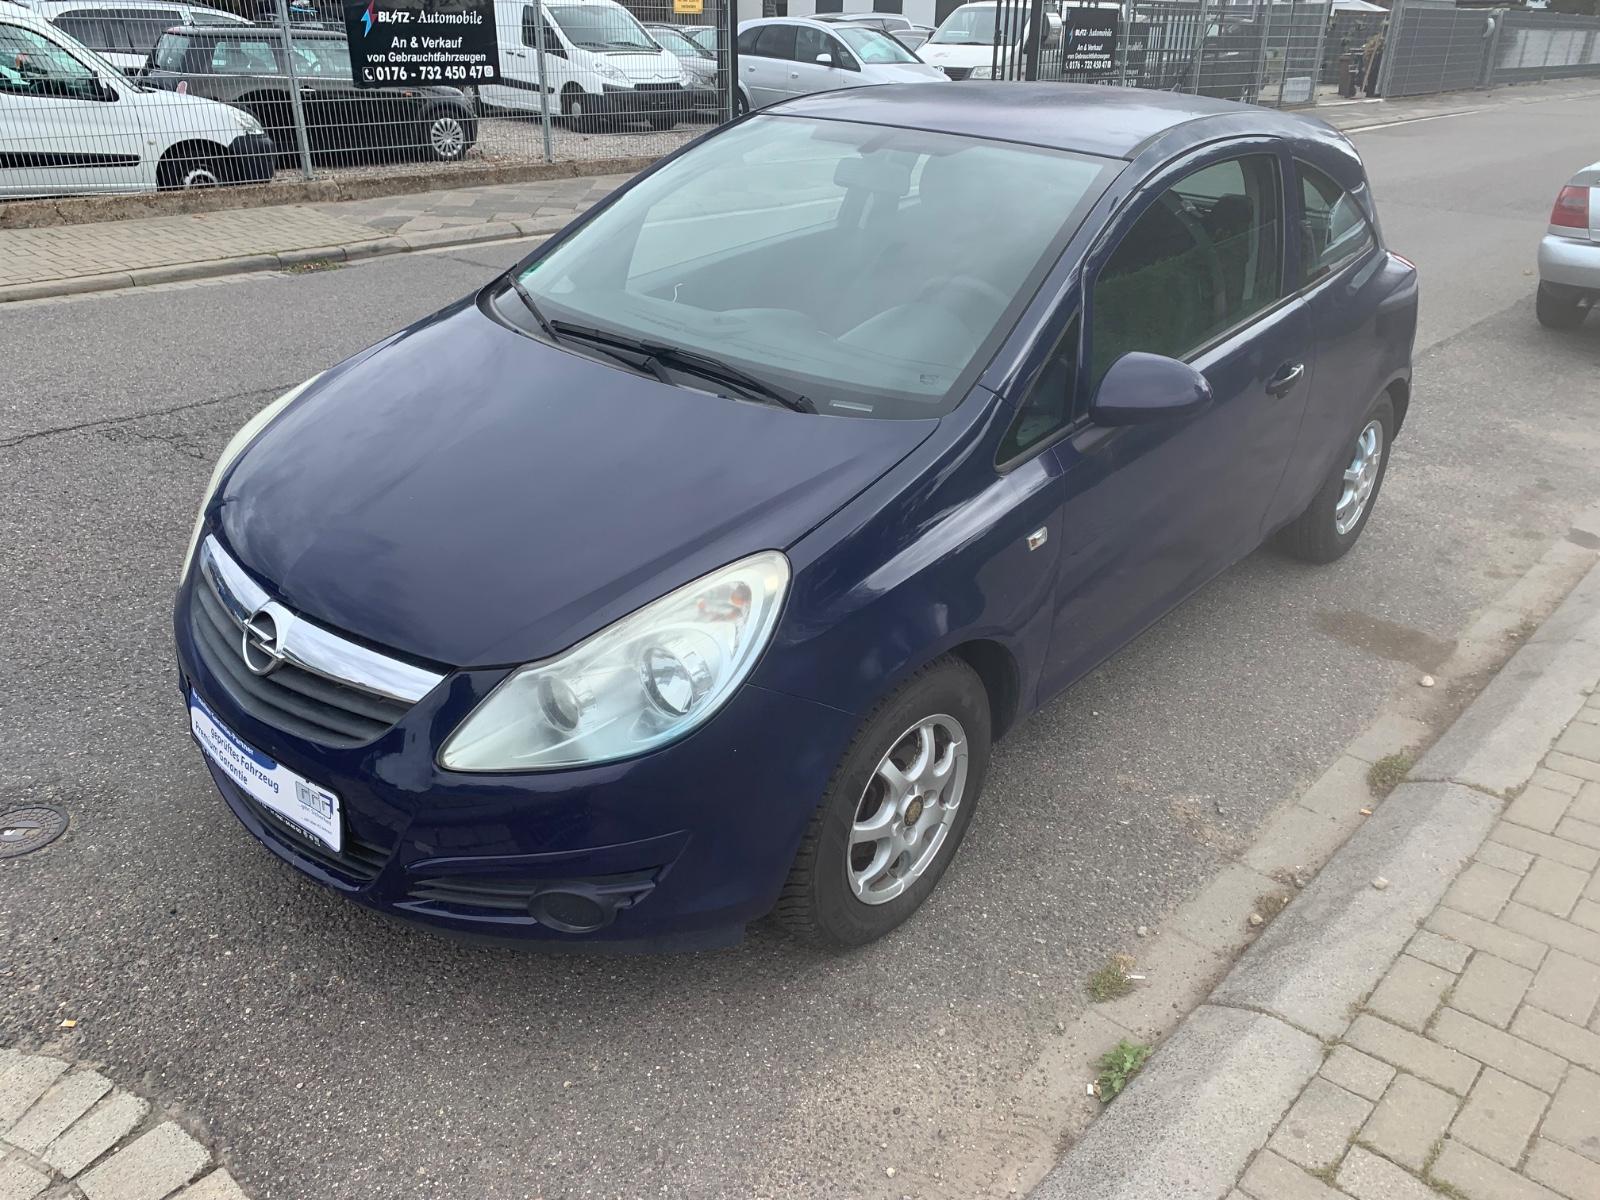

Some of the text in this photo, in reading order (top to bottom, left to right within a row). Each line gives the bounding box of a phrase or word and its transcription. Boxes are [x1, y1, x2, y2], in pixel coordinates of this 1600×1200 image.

[417, 10, 483, 25] Automobile
[391, 36, 463, 49] An & Verkauf
[366, 52, 486, 64] von Gebrauchtfahrzeugen
[375, 66, 408, 81] 0176
[419, 66, 442, 80] 732
[445, 65, 467, 79] 450
[469, 65, 483, 79] 47
[194, 720, 219, 755] Premium
[218, 750, 248, 785] Garantie
[210, 726, 240, 762] geprüftes
[240, 755, 279, 794] Fahrzeug
